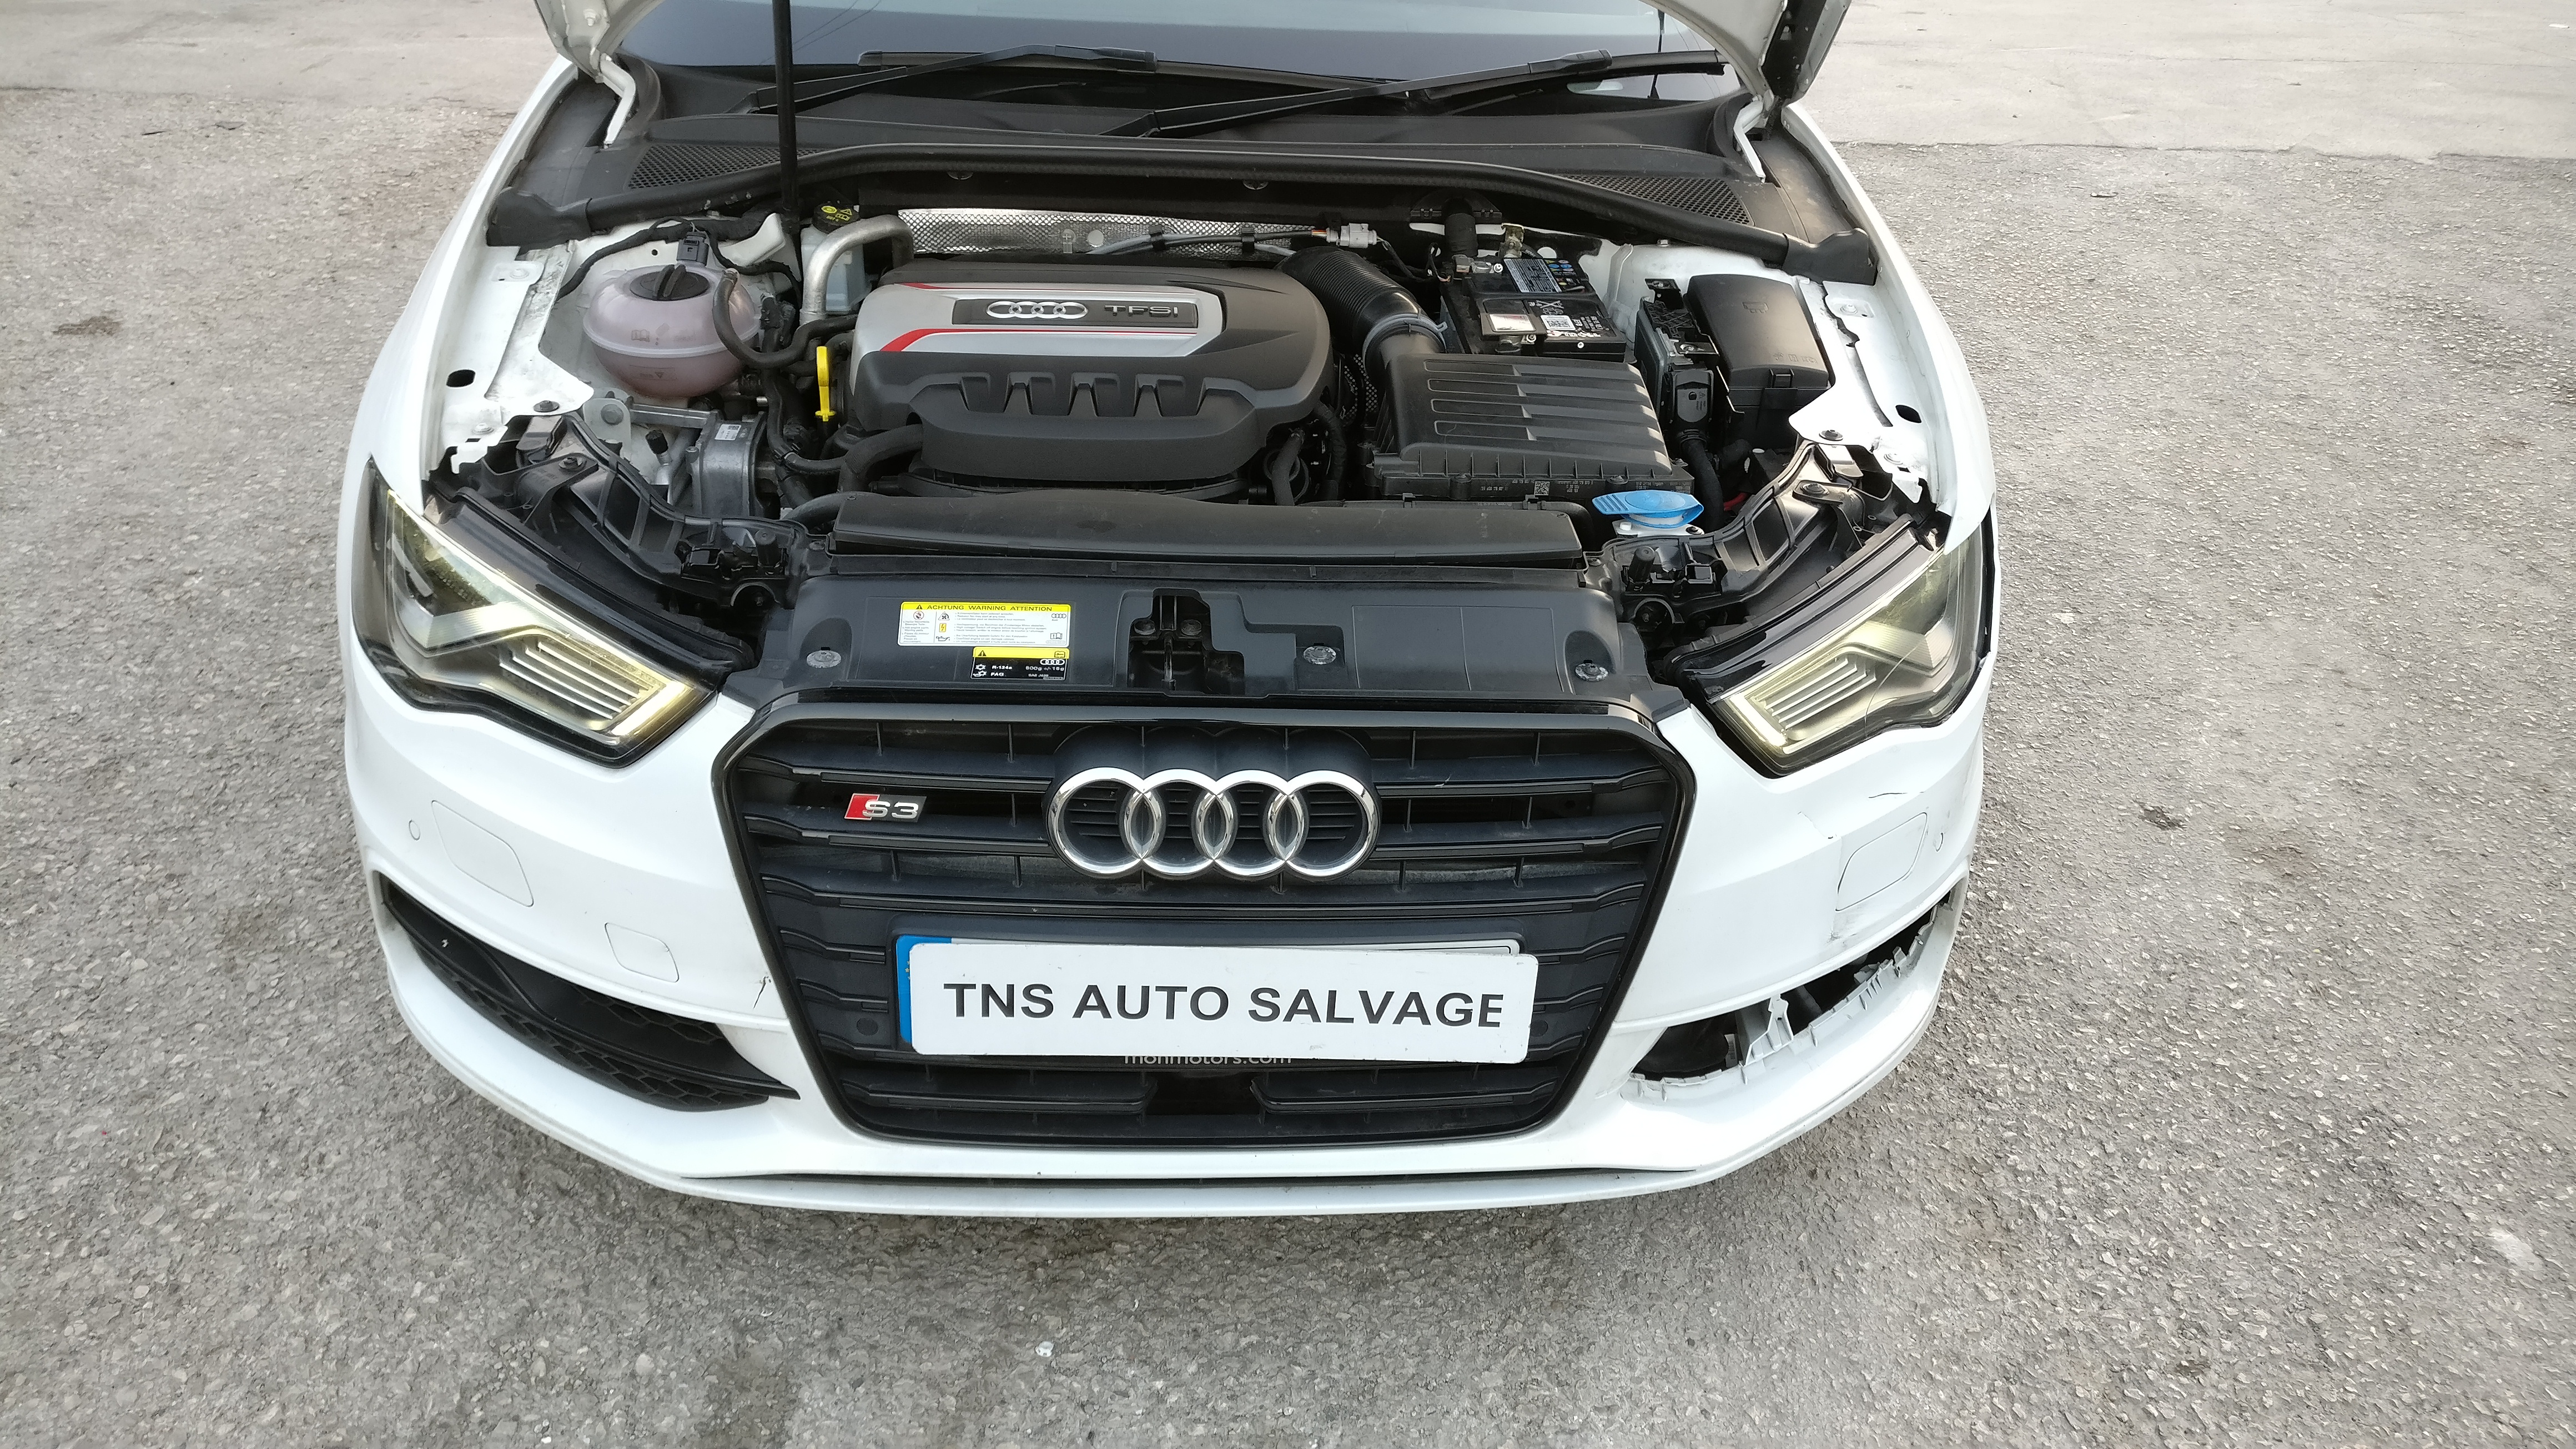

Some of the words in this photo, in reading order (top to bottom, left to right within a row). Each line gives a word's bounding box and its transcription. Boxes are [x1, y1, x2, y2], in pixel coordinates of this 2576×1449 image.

[1104, 305, 1178, 315] TFSI
[862, 799, 919, 819] S3
[944, 983, 1053, 1018] TNS
[1073, 984, 1229, 1020] AUTO
[1248, 987, 1504, 1028] SALVAGE
